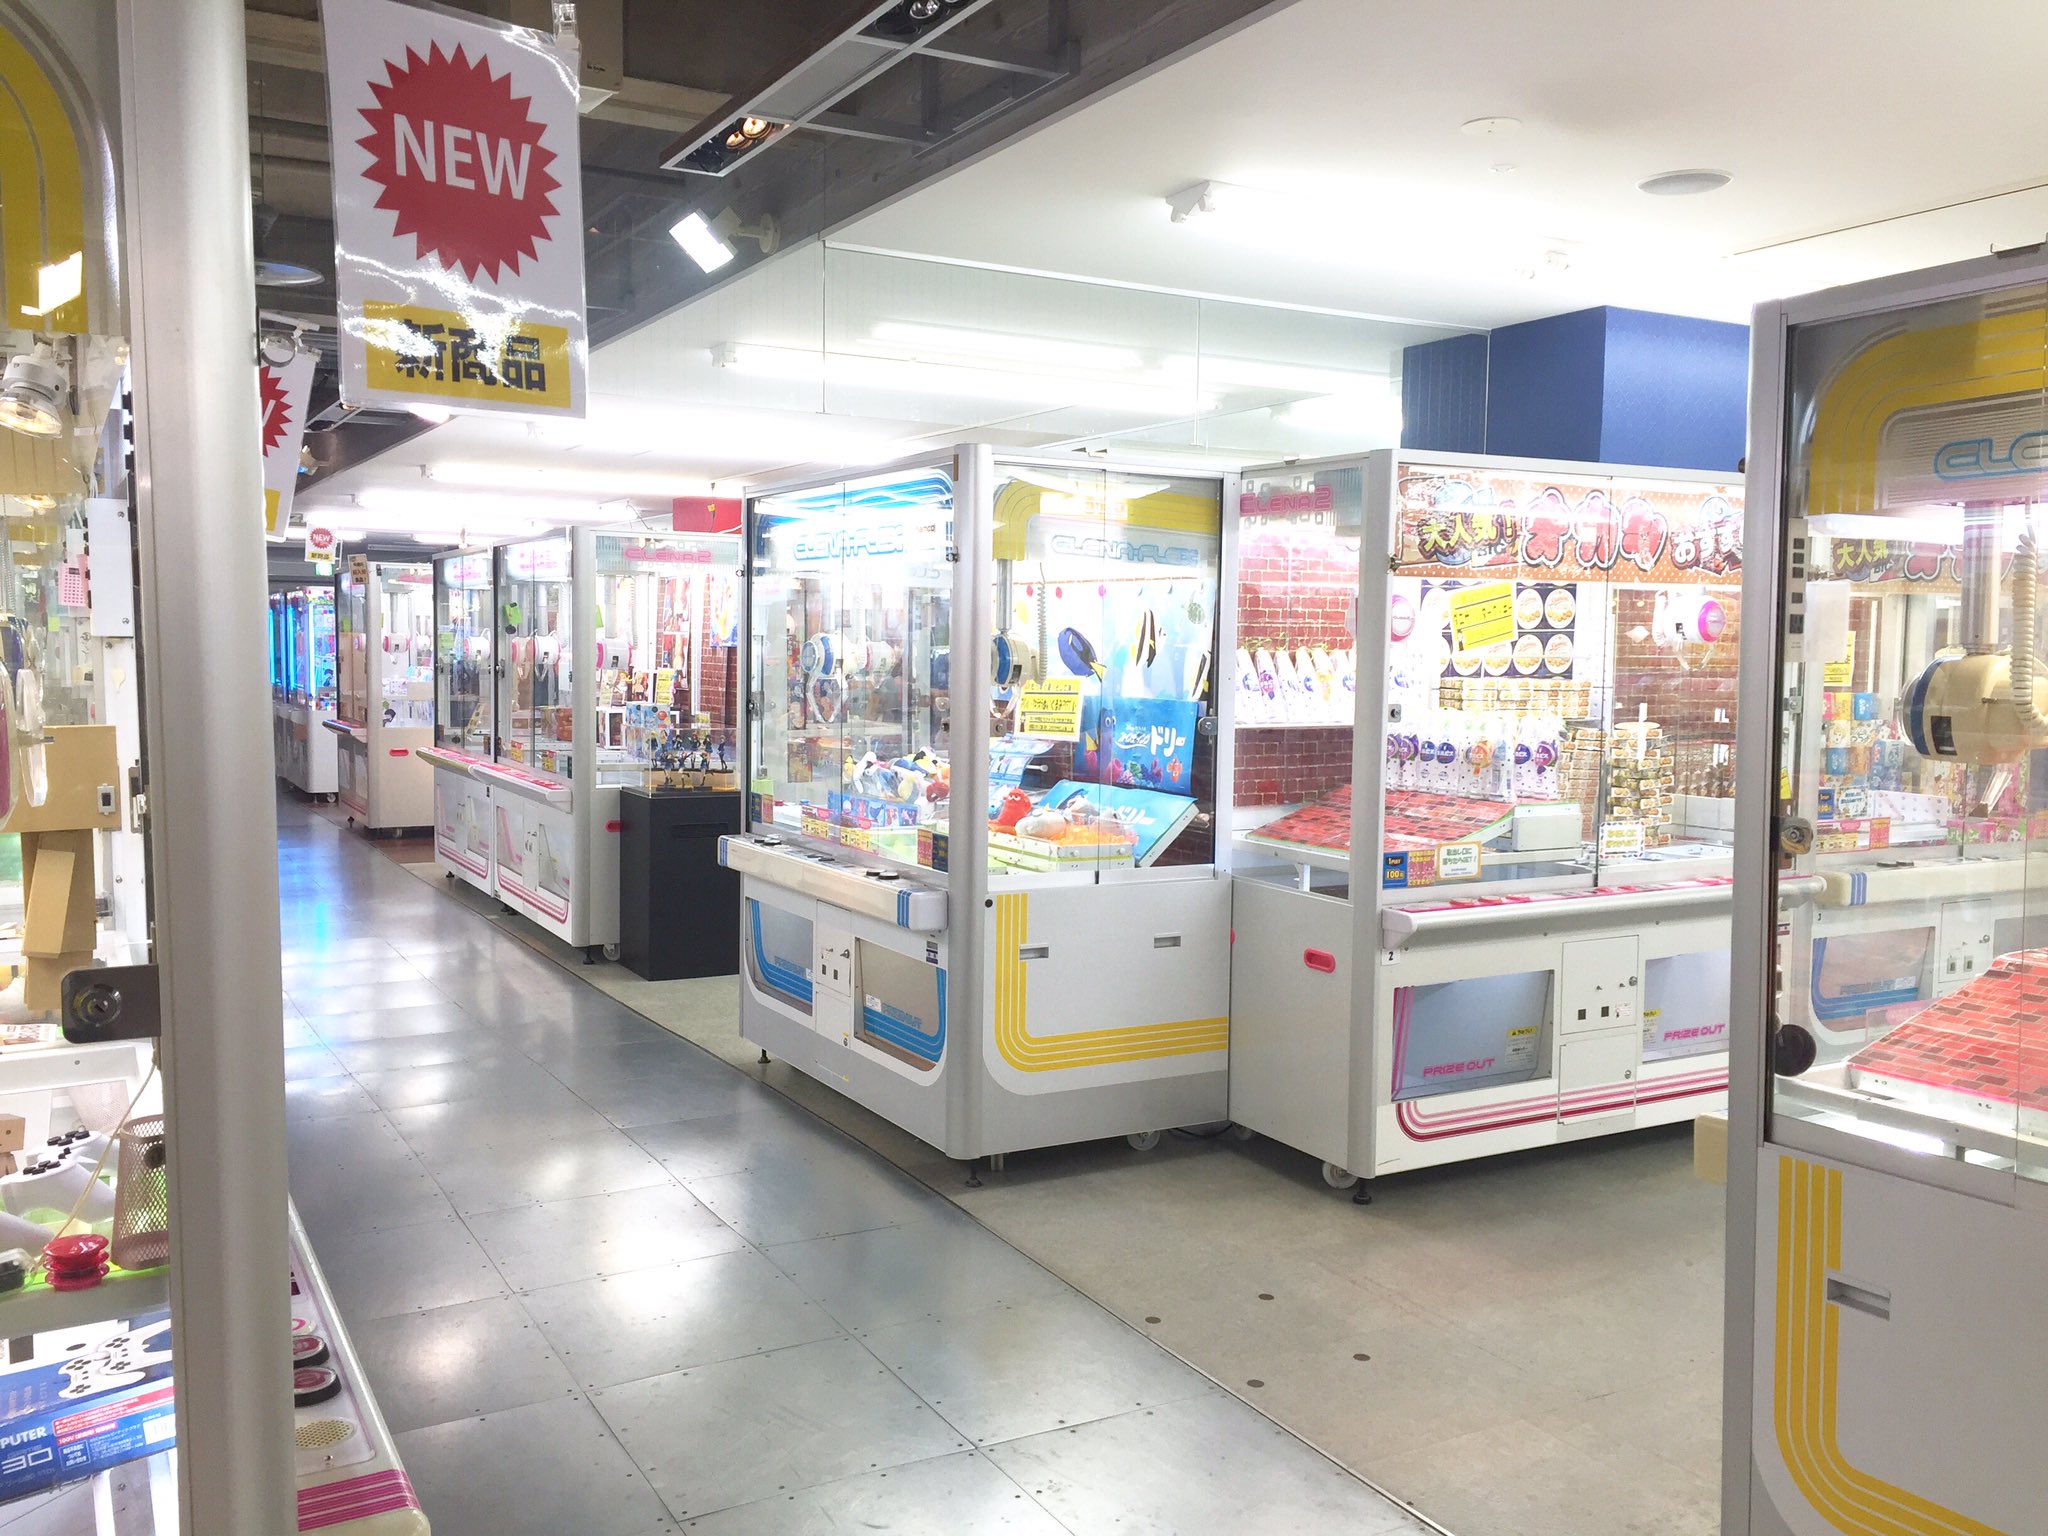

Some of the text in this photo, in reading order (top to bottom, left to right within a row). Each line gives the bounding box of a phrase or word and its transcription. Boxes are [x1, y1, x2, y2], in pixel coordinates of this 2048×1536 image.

[391, 113, 532, 200] NEW
[395, 317, 547, 392] 新商品
[311, 532, 331, 542] NEW
[1150, 725, 1187, 757] ドリー
[1387, 951, 1394, 961] 2
[1664, 1026, 1699, 1041] PRIZE
[1700, 1023, 1726, 1038] OUT
[1423, 1058, 1496, 1078] PRIZE OUT
